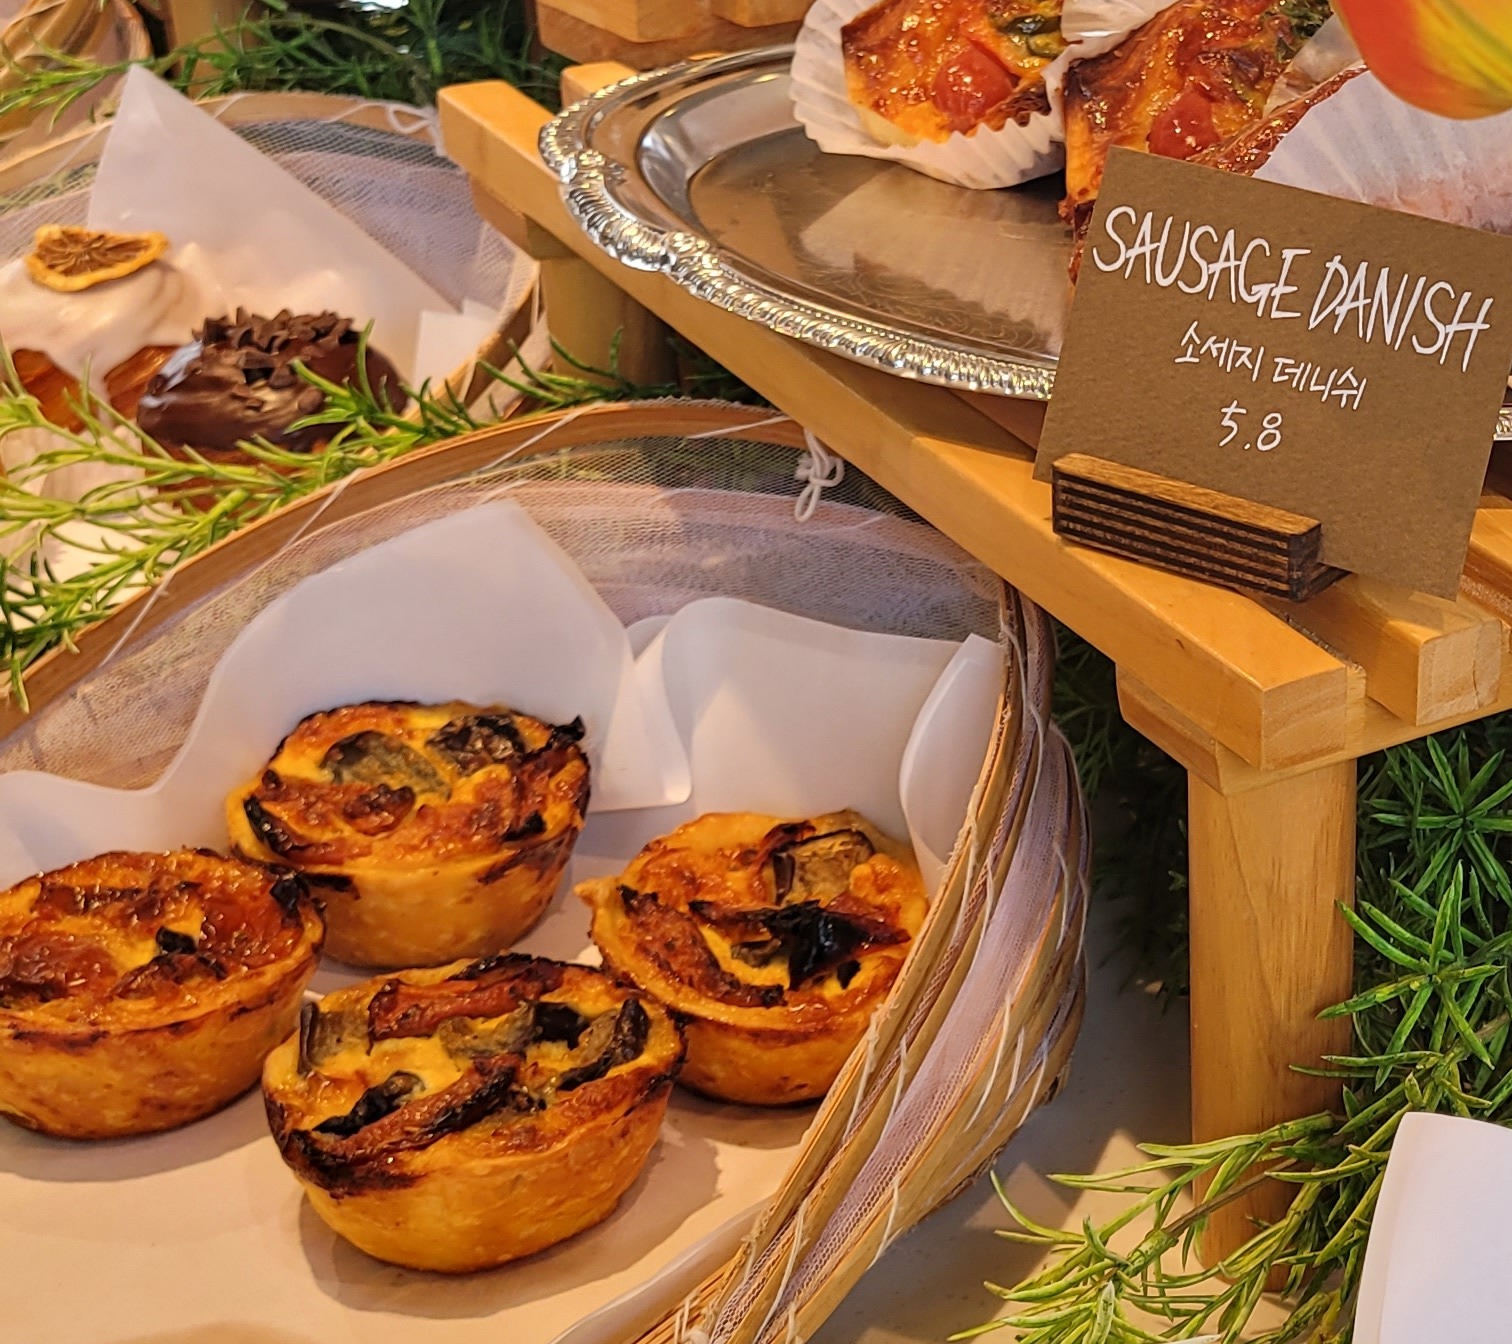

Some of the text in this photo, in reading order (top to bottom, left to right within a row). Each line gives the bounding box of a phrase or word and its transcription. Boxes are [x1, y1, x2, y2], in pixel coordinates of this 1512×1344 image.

[1092, 205, 1494, 373] SAUSAGE DANISH
[1174, 320, 1368, 411] 소세지 데니쉬
[1218, 400, 1283, 452] 5.8
